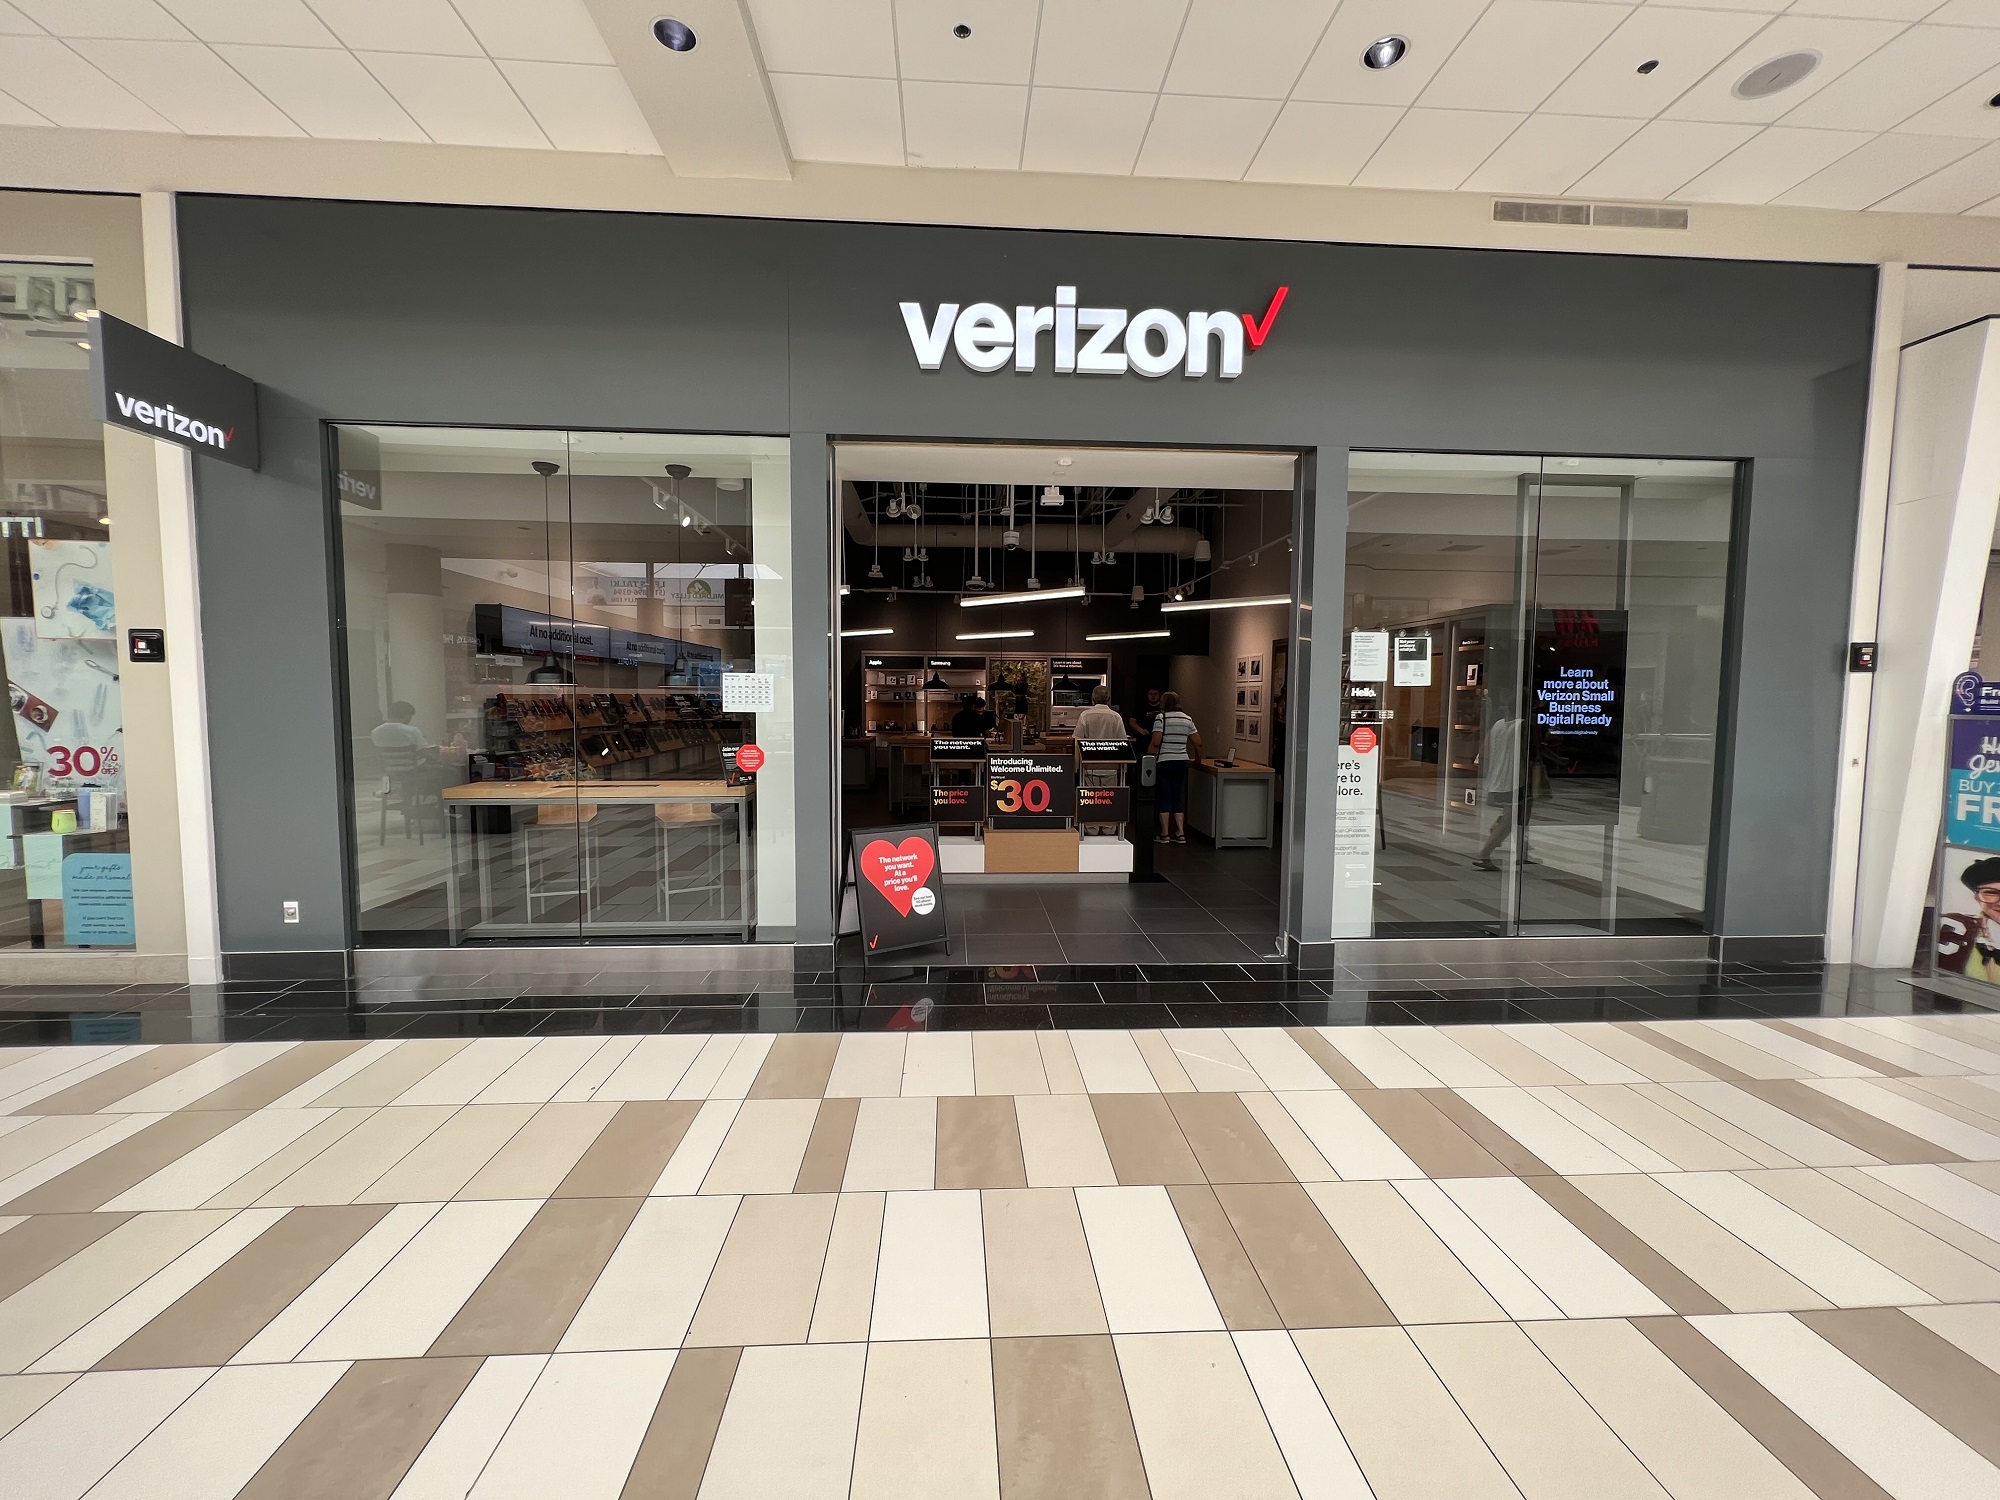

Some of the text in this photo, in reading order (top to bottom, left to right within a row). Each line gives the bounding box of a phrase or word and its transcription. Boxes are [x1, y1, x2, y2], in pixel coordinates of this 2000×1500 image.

[899, 285, 1244, 379] verizon
[114, 391, 226, 450] verizon
[529, 624, 538, 637] At
[539, 629, 548, 639] no
[548, 629, 580, 644] additional
[1560, 666, 1594, 678] Learn
[1543, 679, 1609, 689] more about
[1351, 687, 1377, 698] Hello.
[1537, 690, 1614, 701] Verizon Small
[1549, 702, 1602, 713] Business
[1537, 713, 1612, 727] Digital Ready
[990, 758, 1034, 766] Introducing
[990, 764, 1064, 773] Welcome Unlimited.
[1350, 773, 1361, 783] to
[1337, 786, 1363, 796] lore.
[1959, 779, 1995, 794] BUY
[933, 789, 969, 799] The price
[990, 779, 1051, 813] $30
[1079, 789, 1115, 799] The price
[933, 798, 949, 806] you
[1080, 797, 1113, 806] you love.
[878, 853, 918, 864] The network
[884, 861, 914, 872] you want.
[884, 875, 918, 887] price you'll
